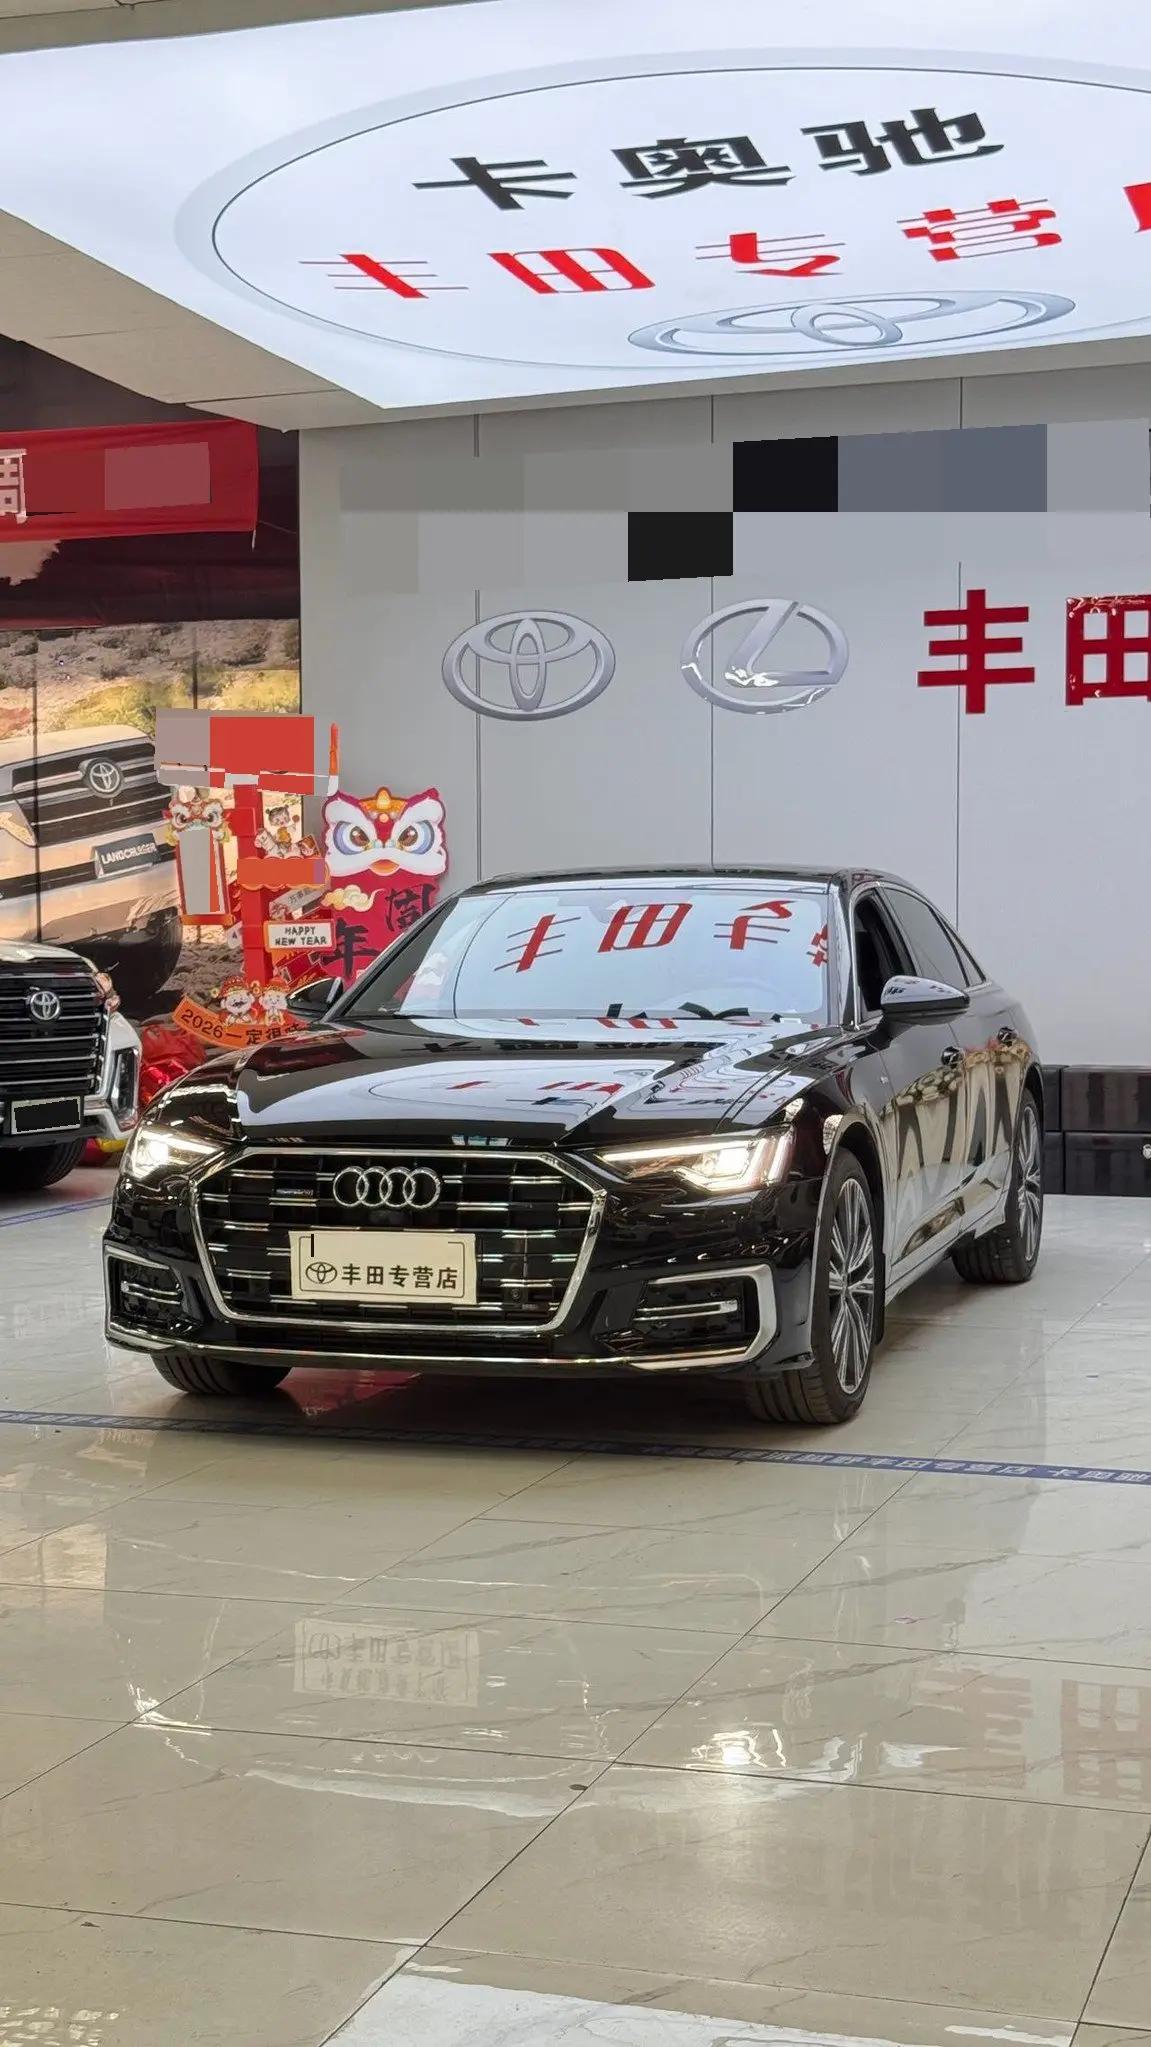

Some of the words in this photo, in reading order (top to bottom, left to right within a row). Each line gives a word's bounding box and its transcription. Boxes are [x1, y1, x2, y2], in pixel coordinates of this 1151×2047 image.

[412, 107, 1004, 211] 卡奥驰
[299, 182, 1151, 299] 丰田专营
[275, 938, 297, 947] NEW
[301, 936, 327, 946] YEAR
[284, 926, 316, 935] HAPPY
[341, 1263, 459, 1290] 丰田专营店
